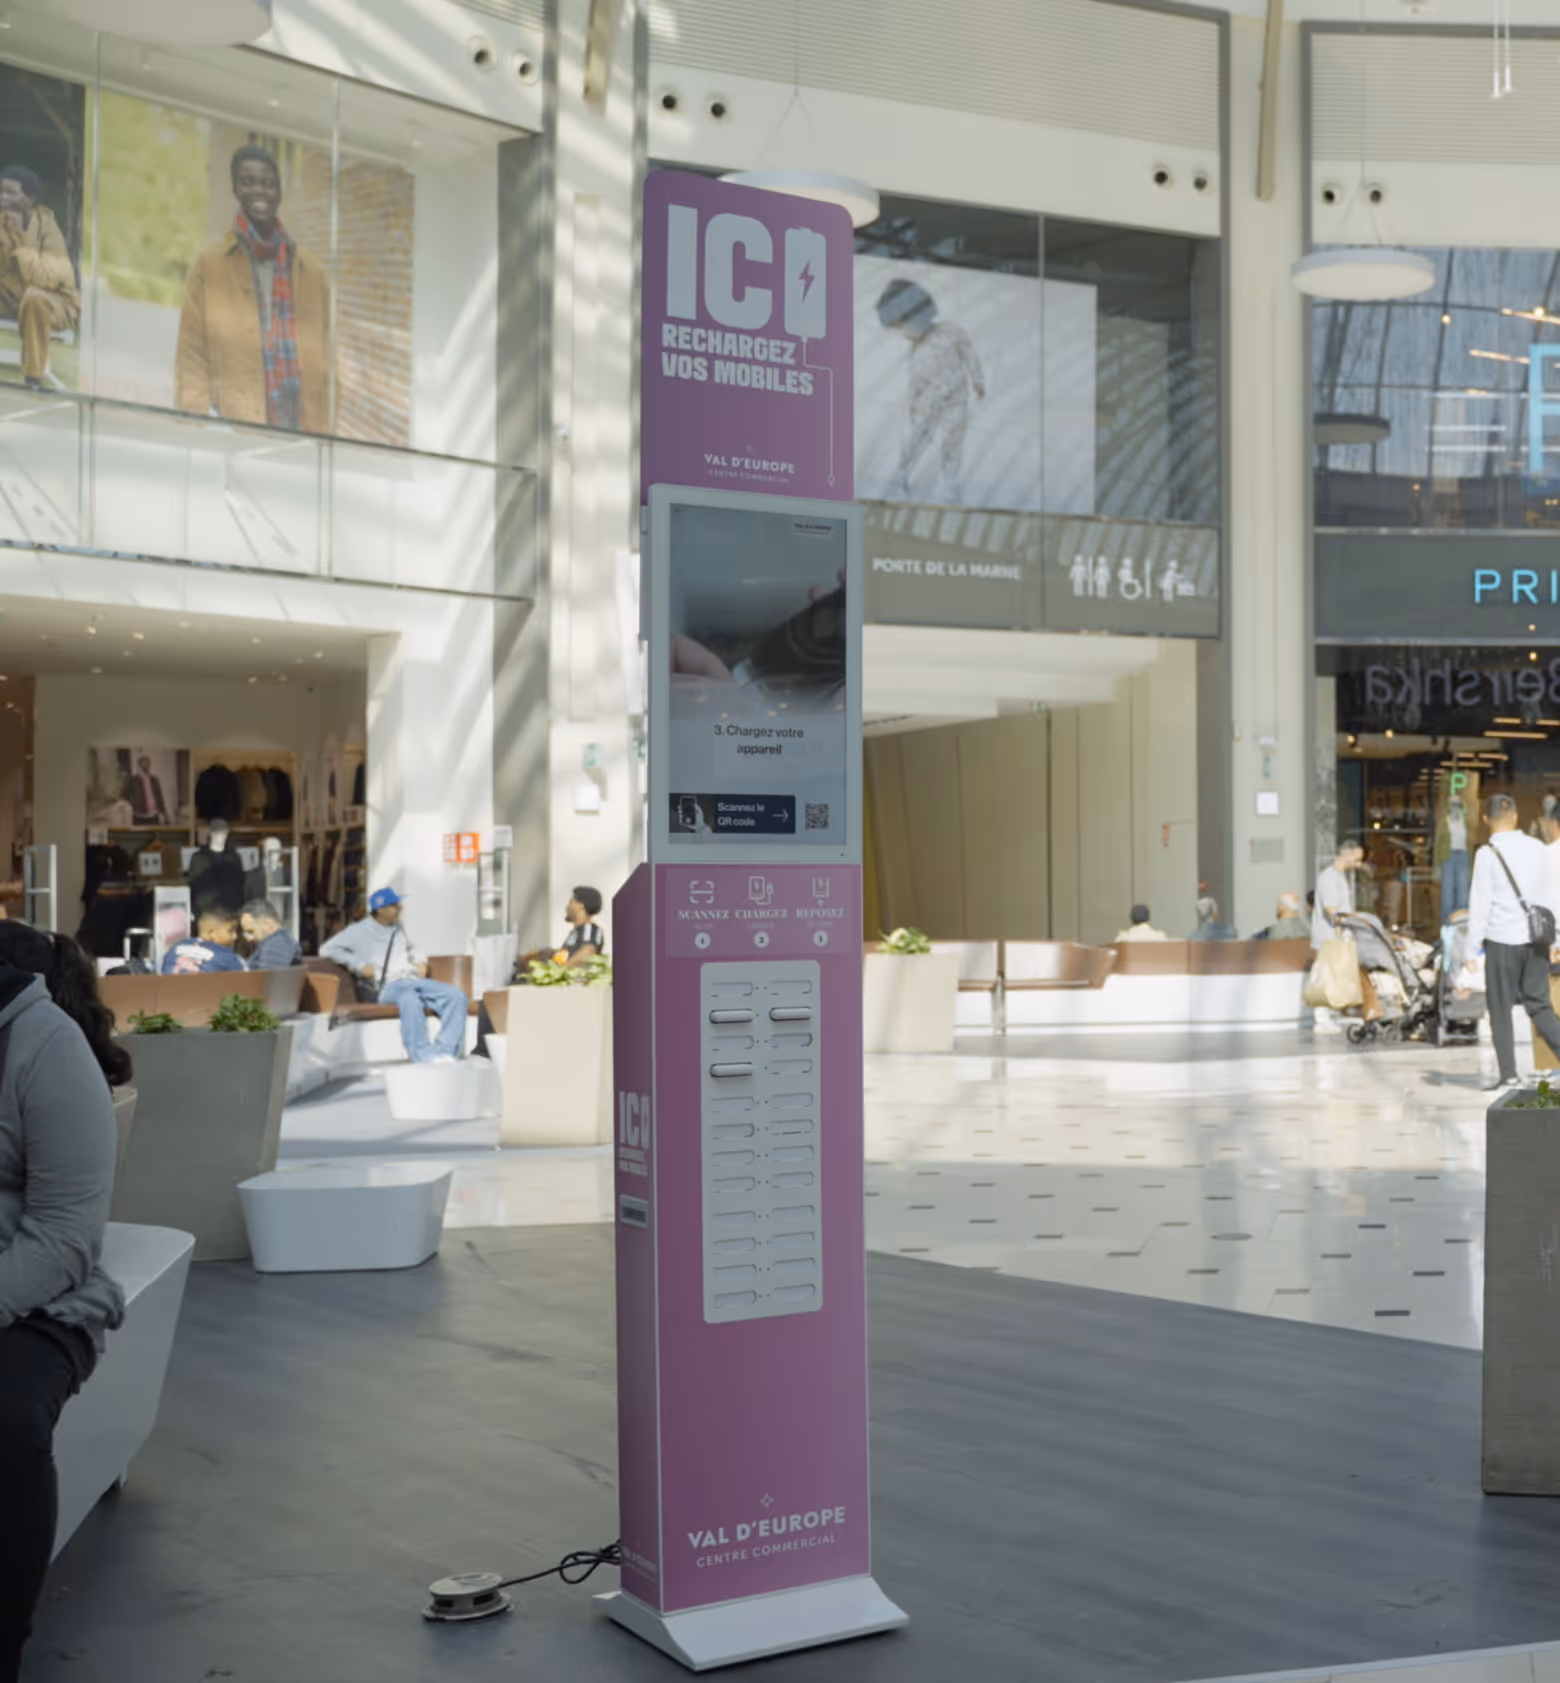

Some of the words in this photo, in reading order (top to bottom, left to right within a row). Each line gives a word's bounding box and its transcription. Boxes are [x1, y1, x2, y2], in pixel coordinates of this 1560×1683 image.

[662, 323, 796, 365] RECHARGEZ
[661, 352, 708, 382] VOS
[714, 359, 814, 396] MOBILES
[704, 454, 728, 466] VAL
[732, 457, 795, 474] D'EUROPE
[872, 557, 922, 575] PORTE
[925, 560, 945, 576] DE
[949, 562, 967, 576] LA
[969, 563, 1022, 580] MARNE
[726, 724, 773, 739] Chargez
[775, 727, 804, 738] votre
[736, 744, 782, 756] appareil
[717, 817, 732, 827] QR
[733, 817, 755, 827] code
[677, 909, 730, 920] SCANNEZ
[735, 908, 788, 919] CHARGEZ
[796, 907, 845, 918] REPOSEZ
[687, 1527, 729, 1549] VAL
[736, 1506, 846, 1541] D'EUROPE
[696, 1549, 748, 1568] CENTRE
[752, 1534, 837, 1558] COMMERCIAL
